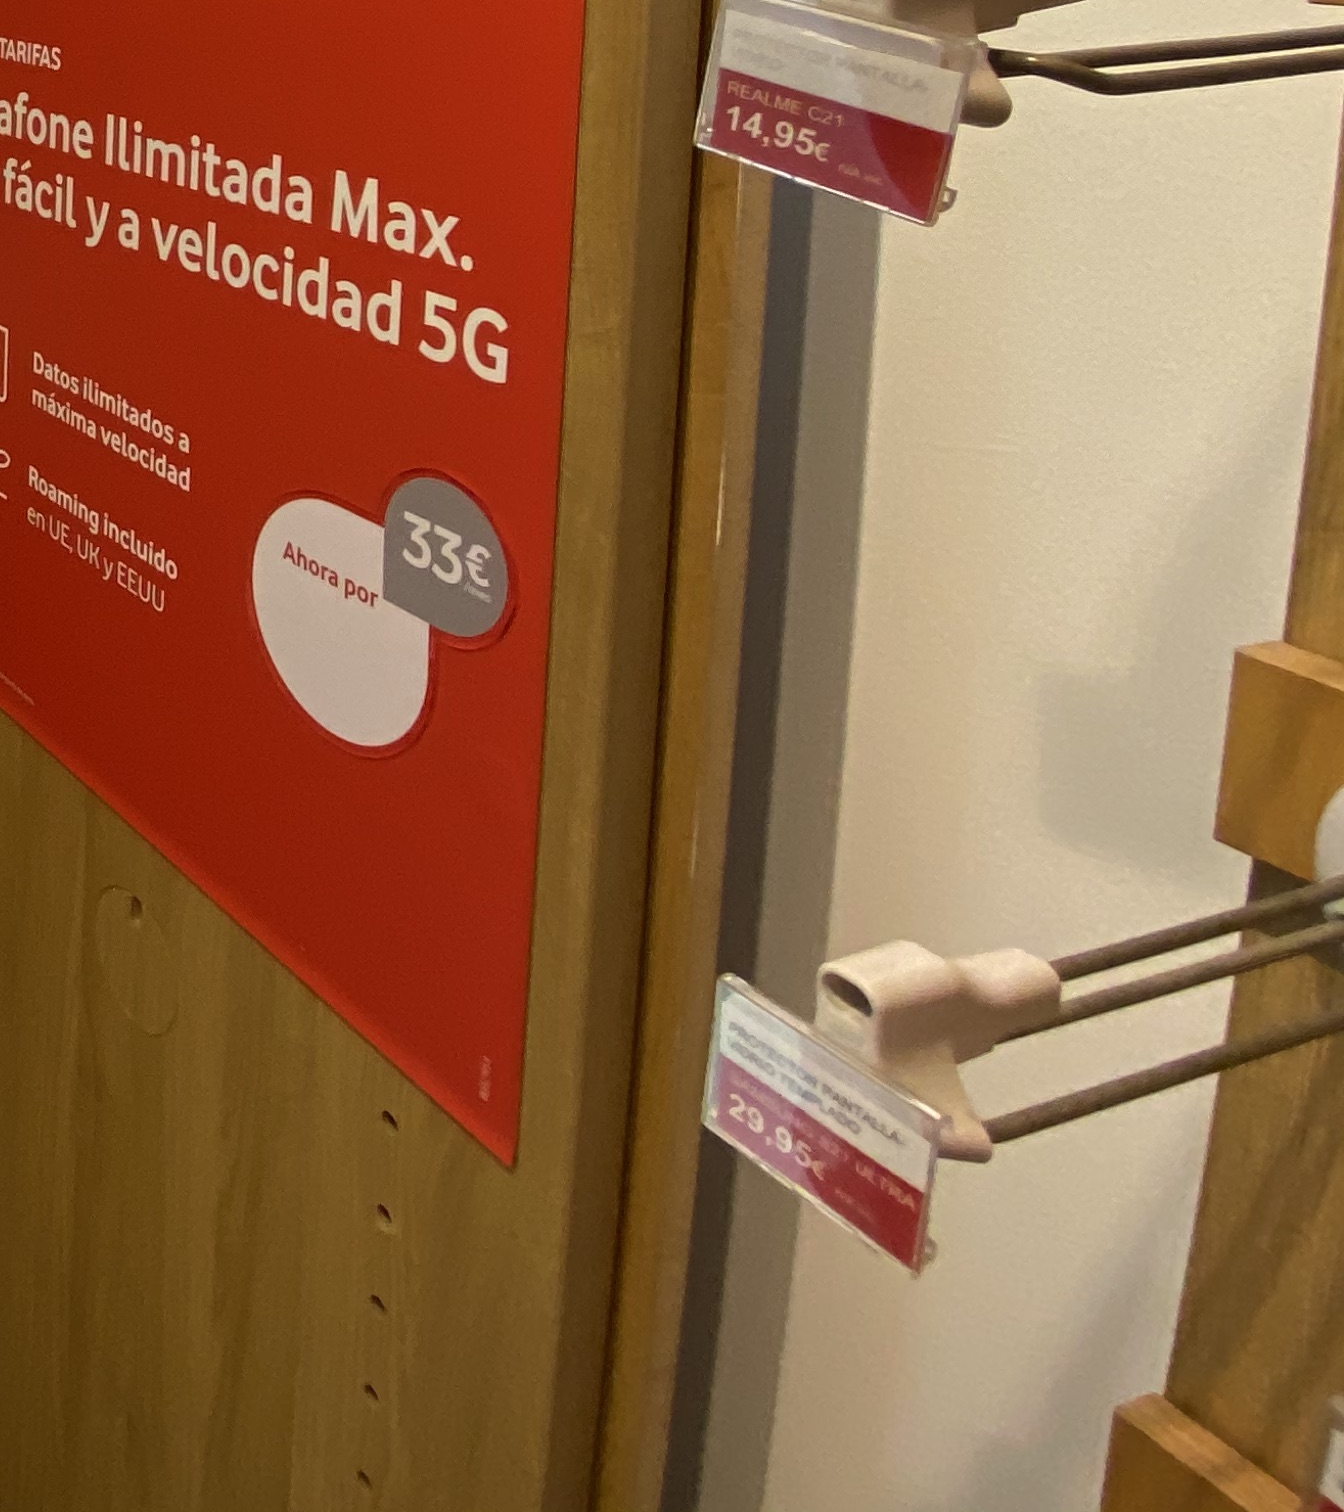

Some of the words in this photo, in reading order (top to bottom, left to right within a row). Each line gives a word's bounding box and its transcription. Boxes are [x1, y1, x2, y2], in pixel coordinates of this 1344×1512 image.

[726, 105, 831, 162] 14,95€
[727, 80, 803, 116] REALME
[105, 114, 313, 224] Ilimitada
[330, 169, 474, 271] Max.
[3, 157, 77, 229] fácil
[85, 194, 111, 247] y
[120, 206, 140, 251] a
[151, 221, 402, 346] velocidad
[418, 291, 509, 384] 5G
[32, 389, 97, 439] máxima
[100, 426, 191, 492] velocidad
[33, 351, 79, 395] Datos
[82, 376, 174, 445] ilimitados
[178, 432, 190, 454] a
[27, 506, 46, 532] en
[49, 515, 73, 554] UE,
[77, 534, 100, 570] UK
[102, 557, 113, 581] y
[117, 561, 165, 612] EEUU
[28, 464, 99, 535] Roaming
[103, 512, 178, 580] incluido
[402, 510, 491, 588] 33€
[282, 541, 338, 588] Ahora
[344, 576, 379, 610] por
